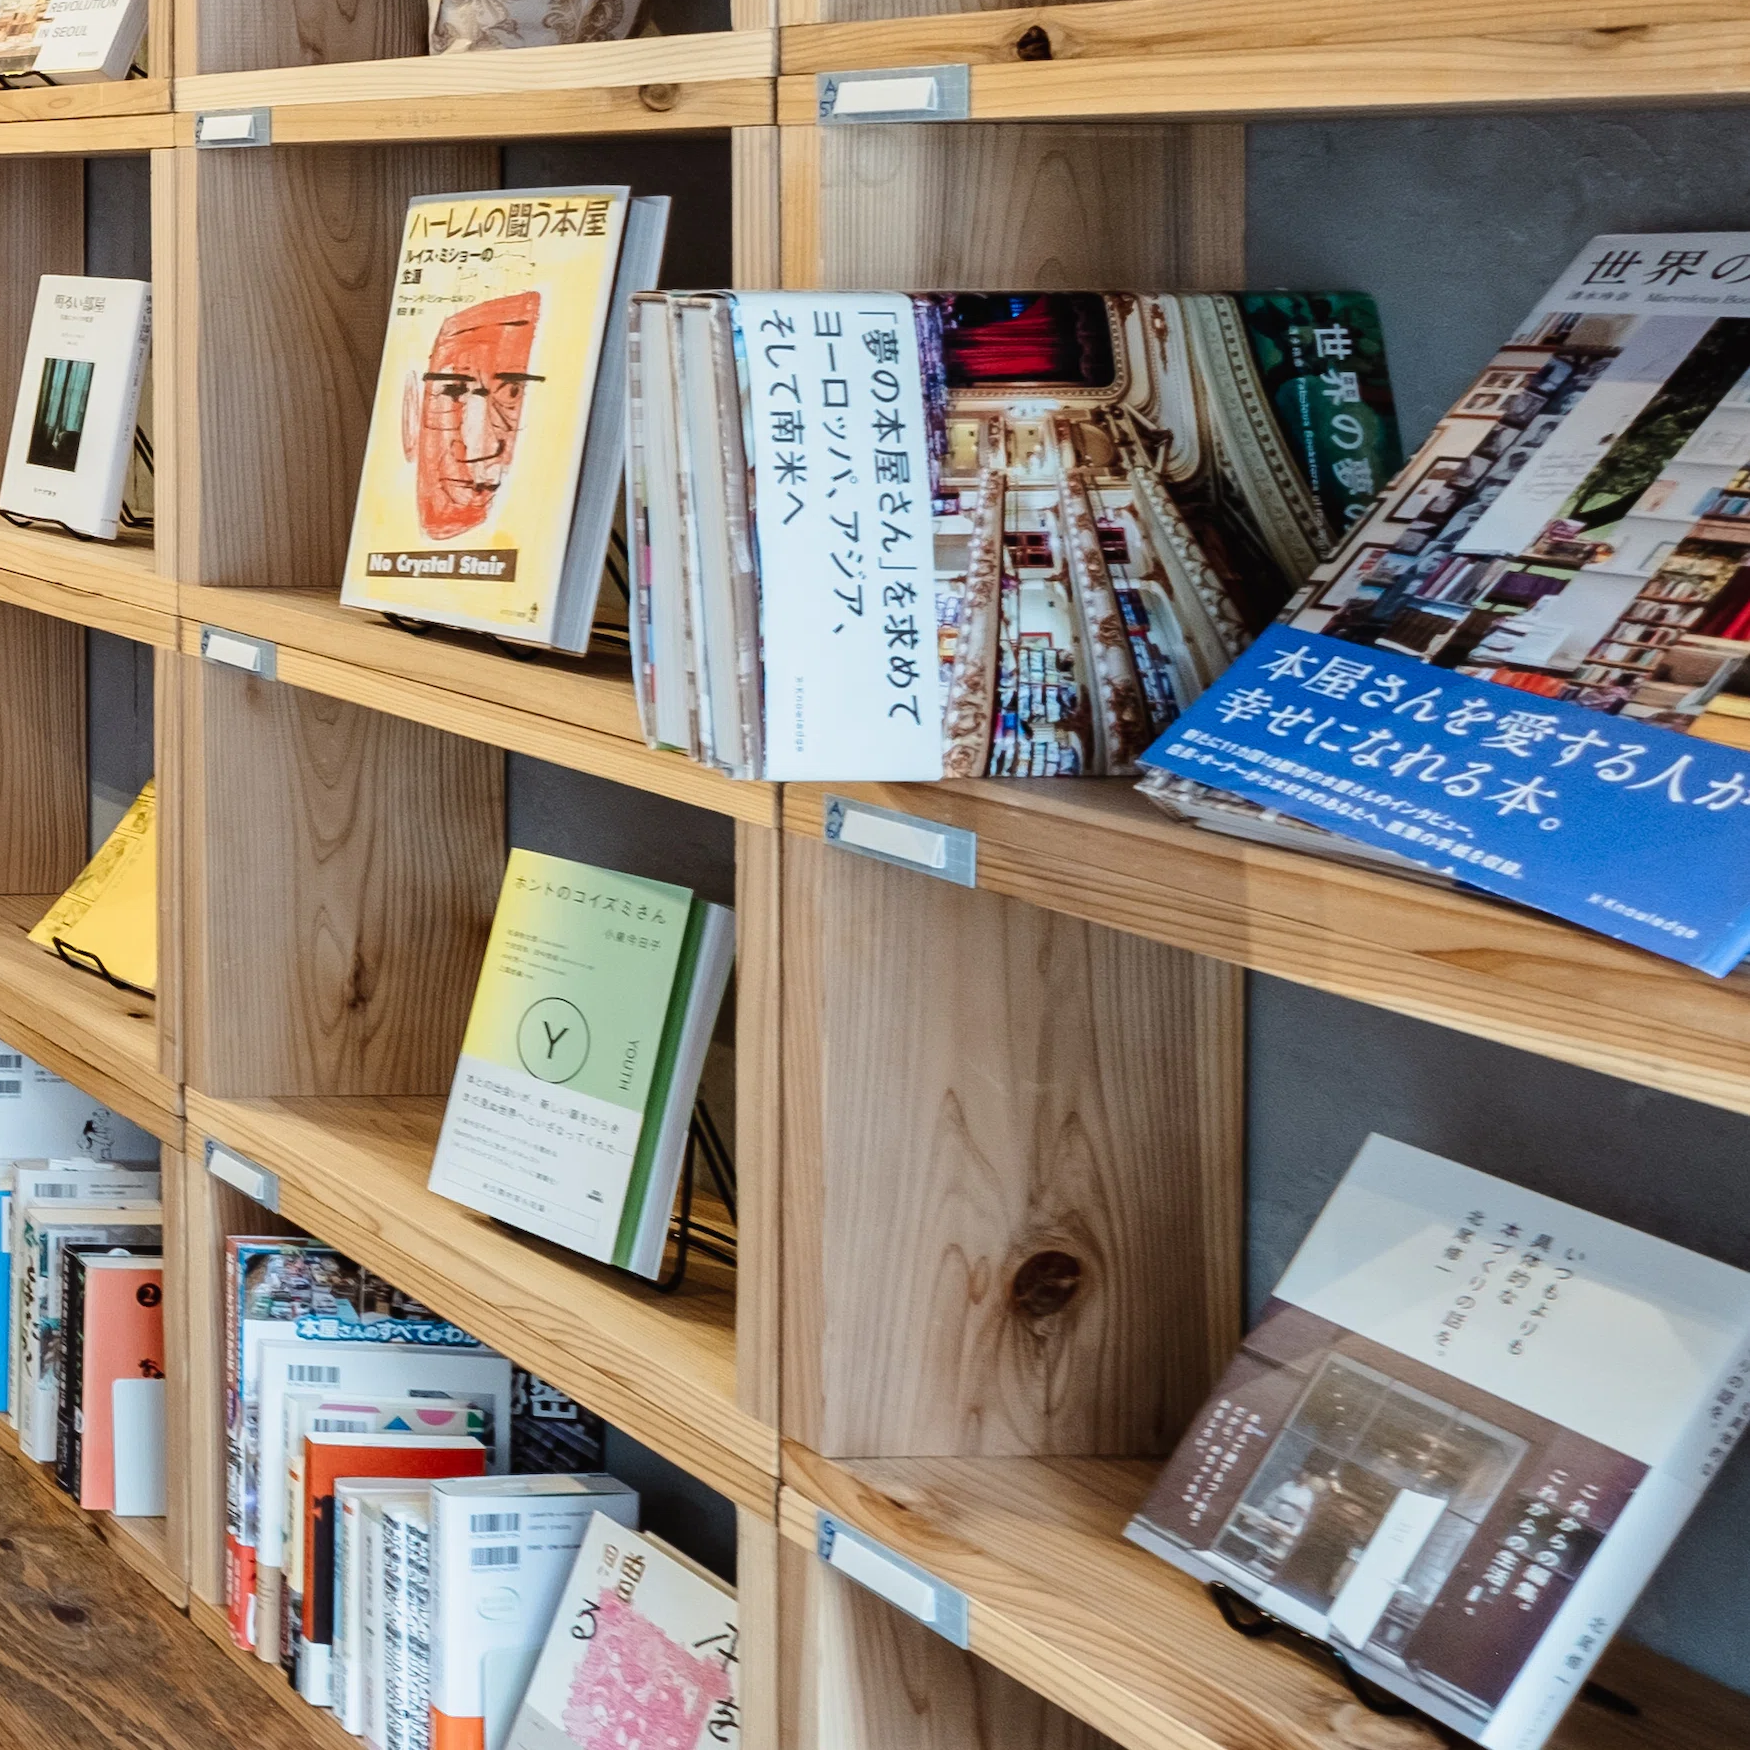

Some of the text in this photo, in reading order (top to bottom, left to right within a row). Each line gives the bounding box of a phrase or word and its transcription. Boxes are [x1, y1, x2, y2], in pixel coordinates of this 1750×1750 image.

[51, 25, 88, 39] SEOUL
[409, 199, 613, 240] ハーレムの闘う本屋
[760, 308, 808, 526] そして南米へ
[813, 308, 867, 635] ヨーロッパ、アジア、
[858, 309, 923, 726] 「夢の本屋さん」を求めて
[368, 552, 508, 578] No Crystal Stair
[1215, 686, 1563, 833] 幸せになれる本。
[1258, 643, 1750, 814] 本屋さんを愛する人が
[513, 875, 669, 927] ホントのコイズミさん
[542, 1019, 570, 1062] Y
[617, 1038, 641, 1093] YOUTH
[1433, 1221, 1524, 1358] 本づくりの話を。
[1499, 1232, 1555, 1306] 具体的な
[1508, 1247, 1586, 1356] いつもよりも
